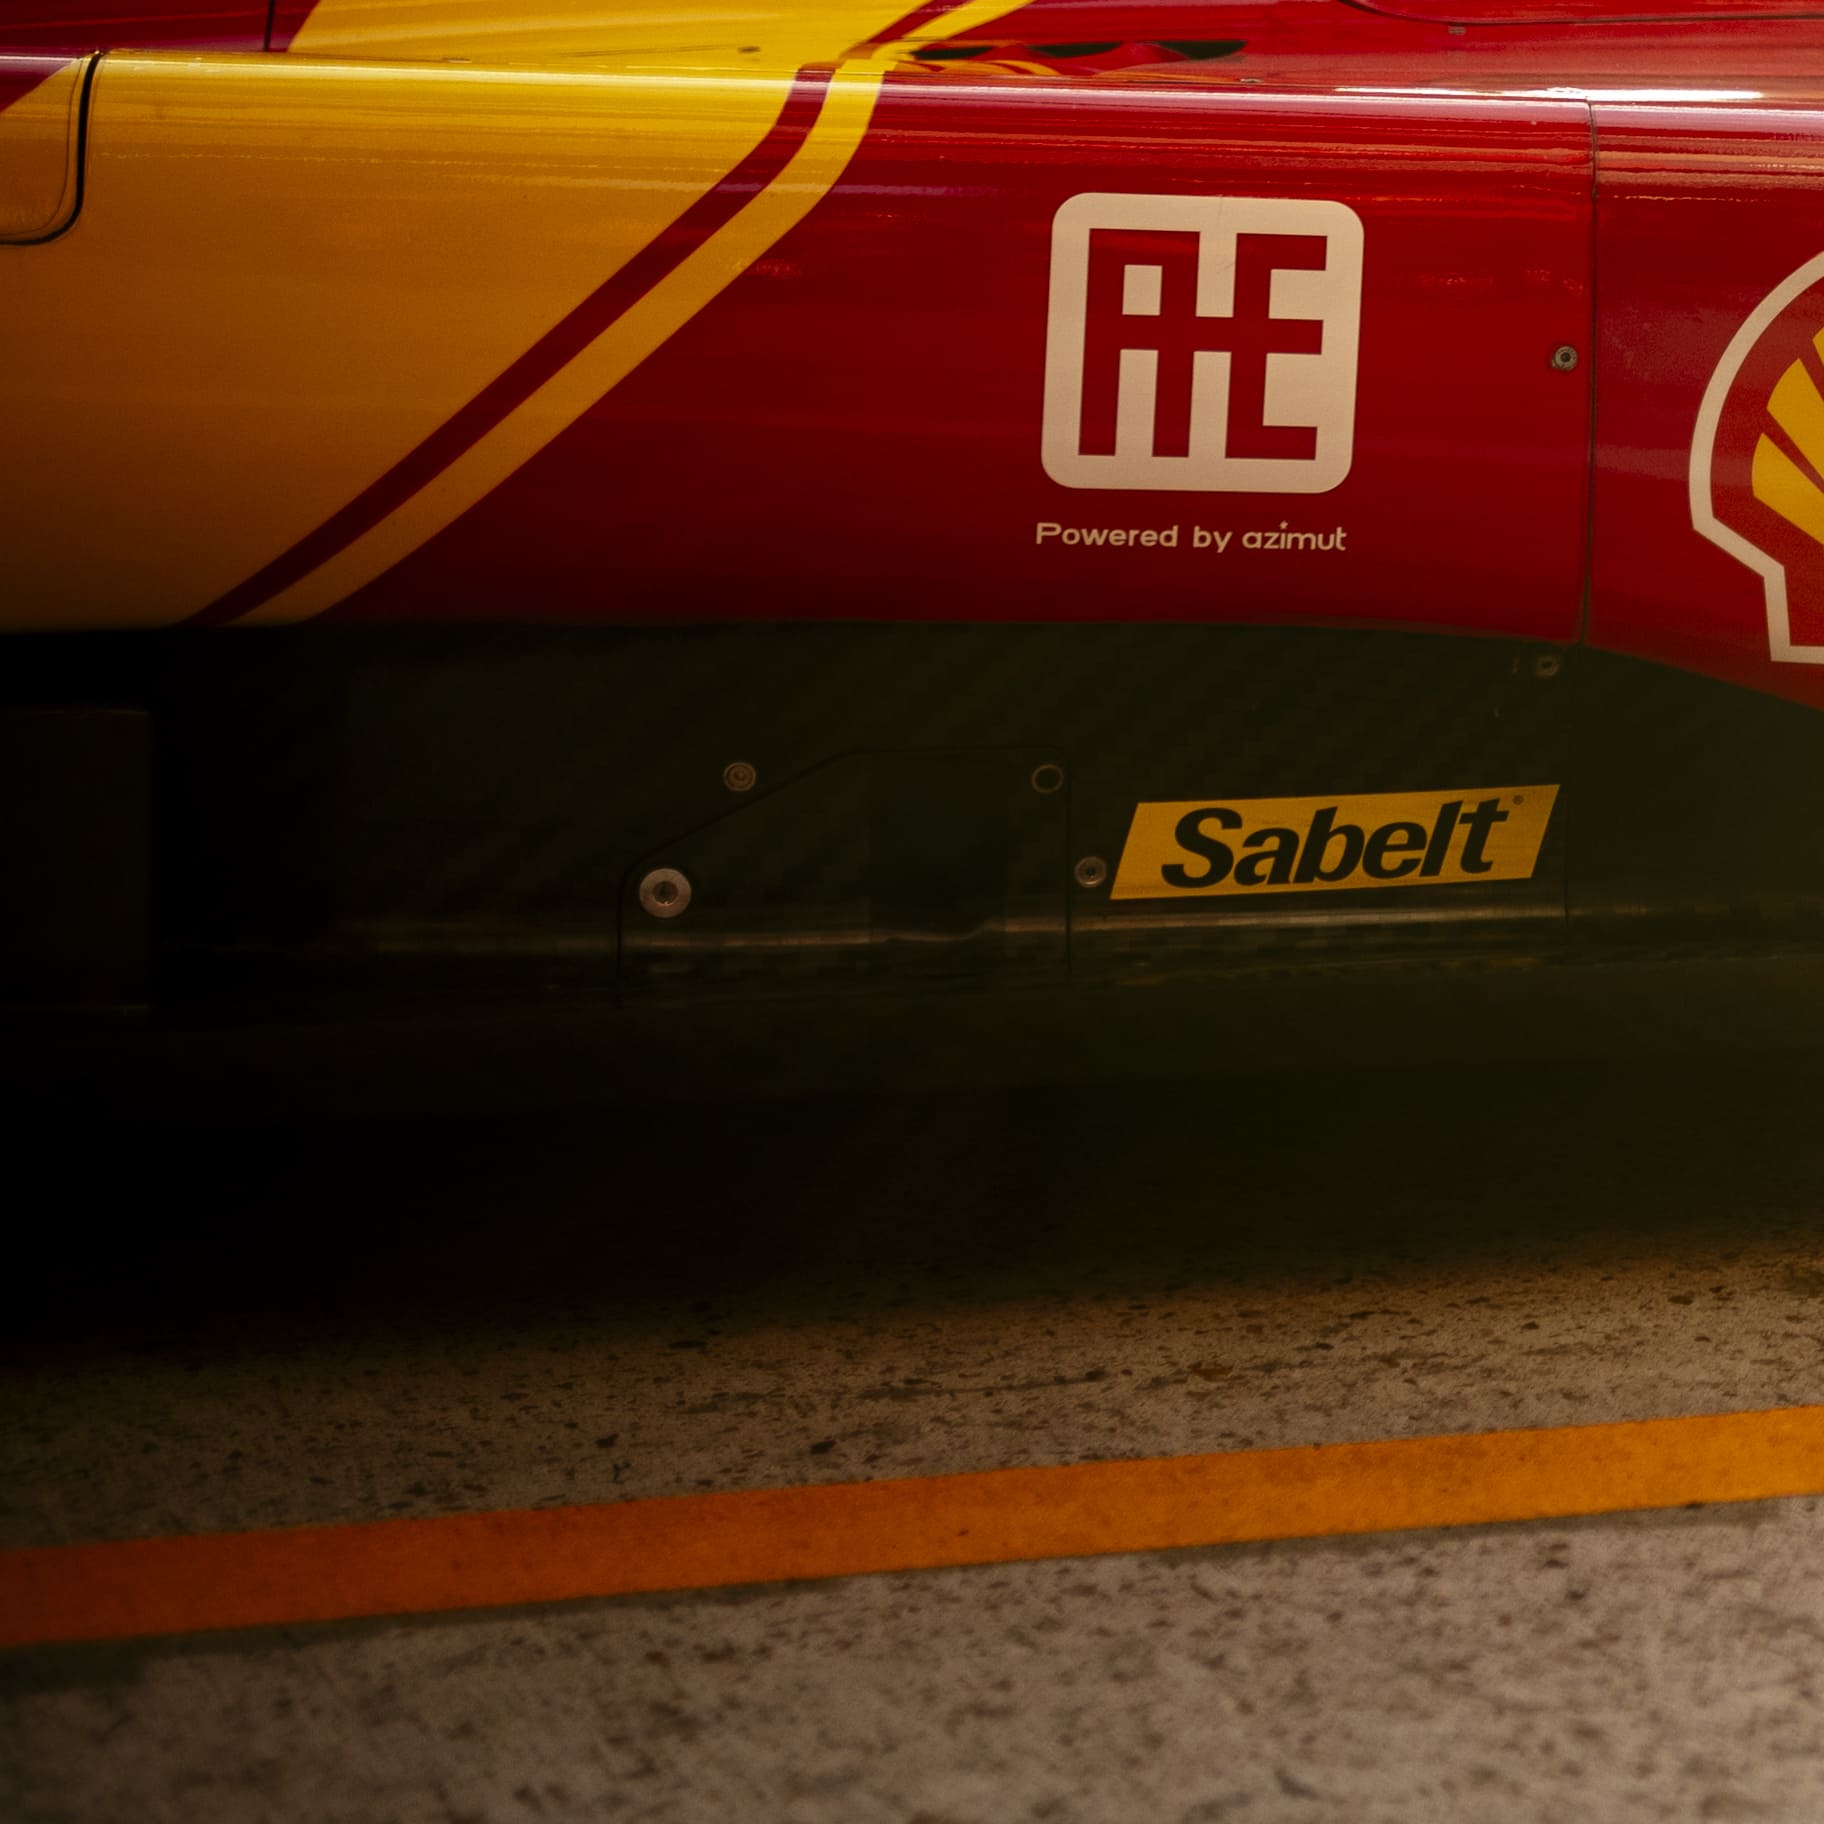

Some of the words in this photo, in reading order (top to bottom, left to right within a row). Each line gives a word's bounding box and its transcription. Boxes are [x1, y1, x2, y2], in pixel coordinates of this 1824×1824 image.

[1036, 522, 1179, 548] Powered
[1193, 526, 1232, 554] by
[1242, 520, 1347, 552] azimut
[1161, 798, 1509, 889] Sabelt
